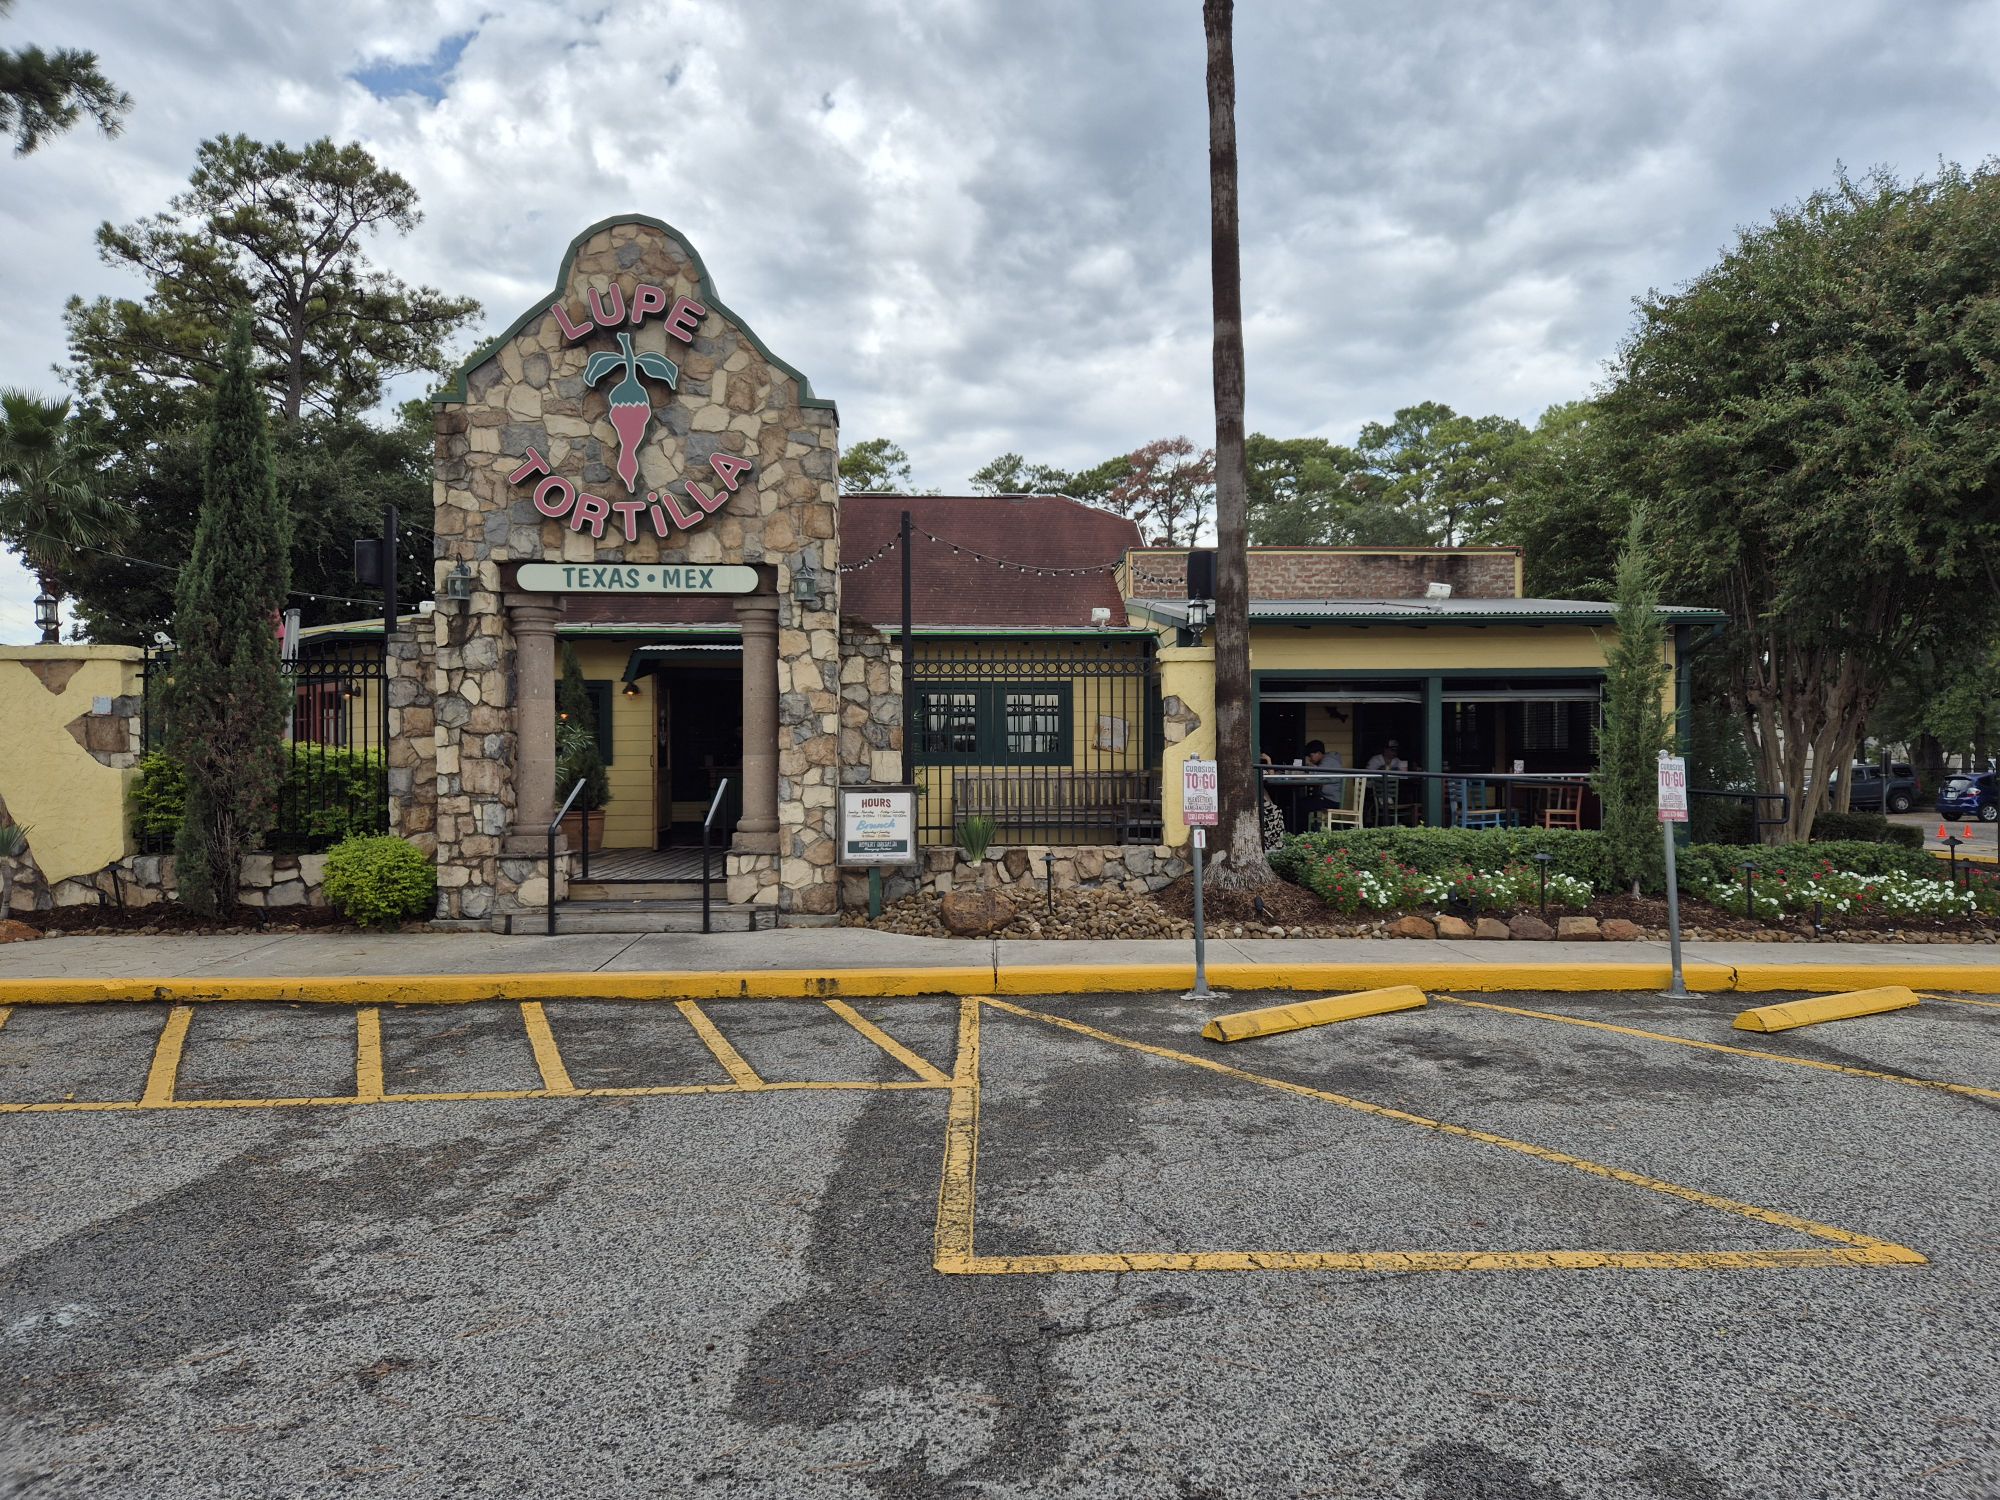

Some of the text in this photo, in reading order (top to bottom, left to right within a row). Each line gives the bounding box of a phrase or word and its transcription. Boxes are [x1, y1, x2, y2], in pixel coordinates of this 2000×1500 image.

[552, 283, 705, 343] LUPE
[562, 567, 713, 589] TEXAS MEX
[1185, 773, 1216, 789] TO GO
[1660, 771, 1684, 787] TO GO
[862, 798, 891, 808] HOURS
[856, 819, 896, 831] Brunch
[1197, 830, 1203, 848] 1
